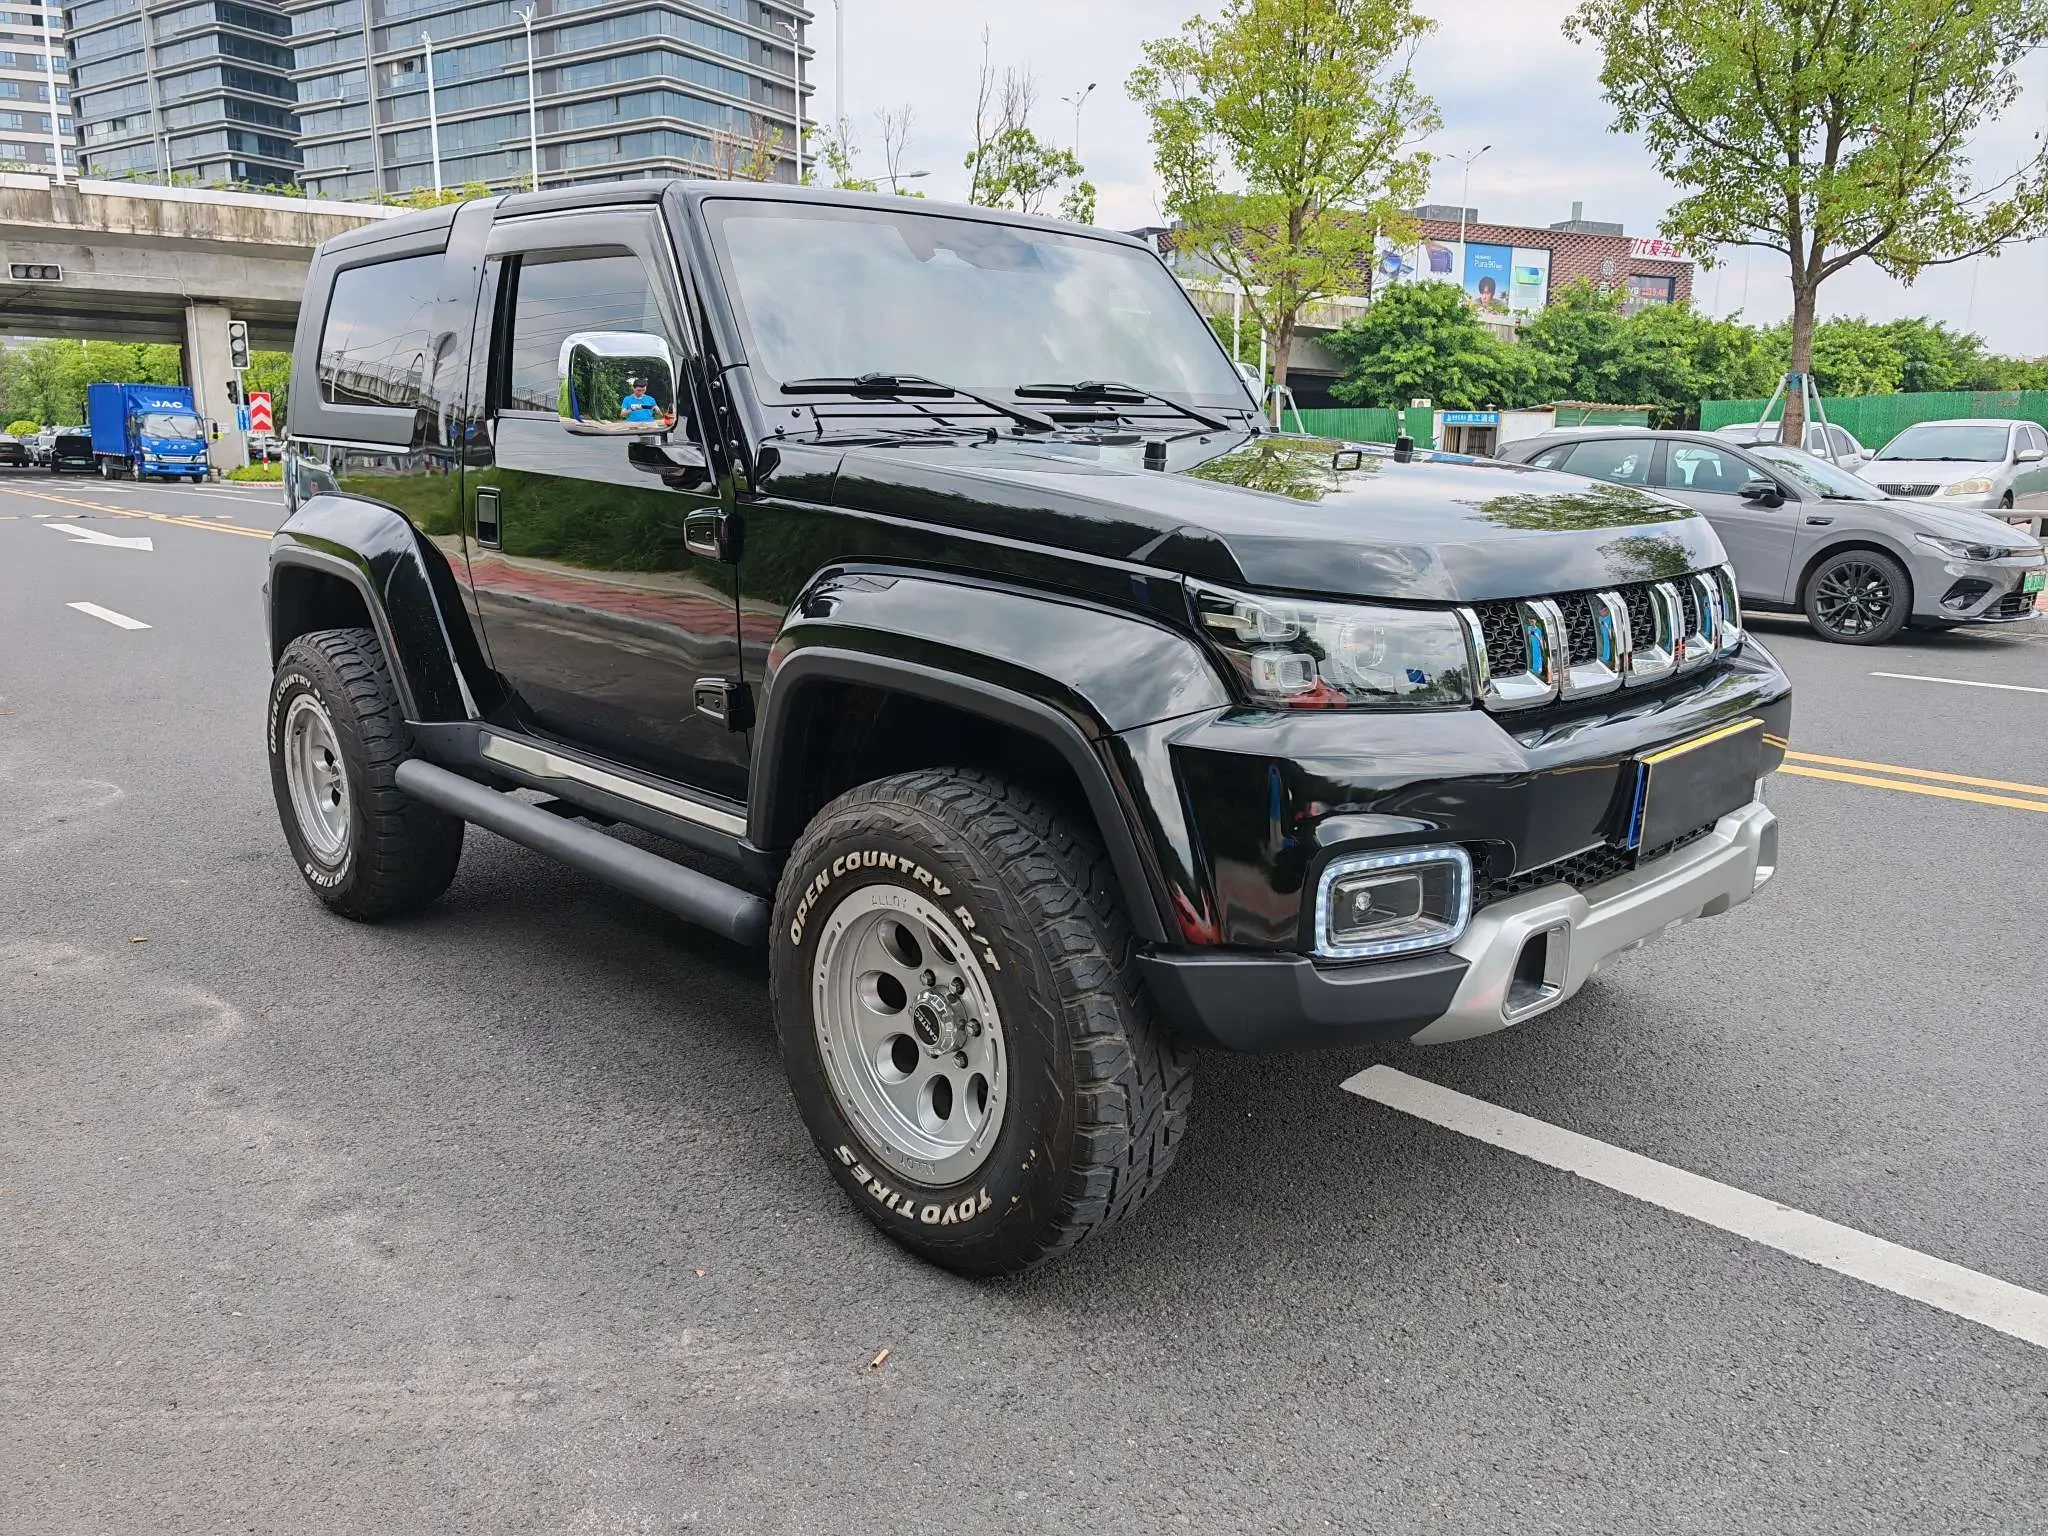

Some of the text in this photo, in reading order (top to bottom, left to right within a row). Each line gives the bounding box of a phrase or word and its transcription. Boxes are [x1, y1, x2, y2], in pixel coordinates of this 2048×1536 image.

[151, 400, 183, 409] JAC
[270, 700, 279, 754] OPEN
[276, 673, 311, 702] COUNTRY
[304, 863, 334, 888] TIRES
[790, 850, 1001, 971] OPEN COUNTRY R/T
[914, 1010, 938, 1042] CARTEC
[833, 1144, 993, 1226] TOYO TIRES
